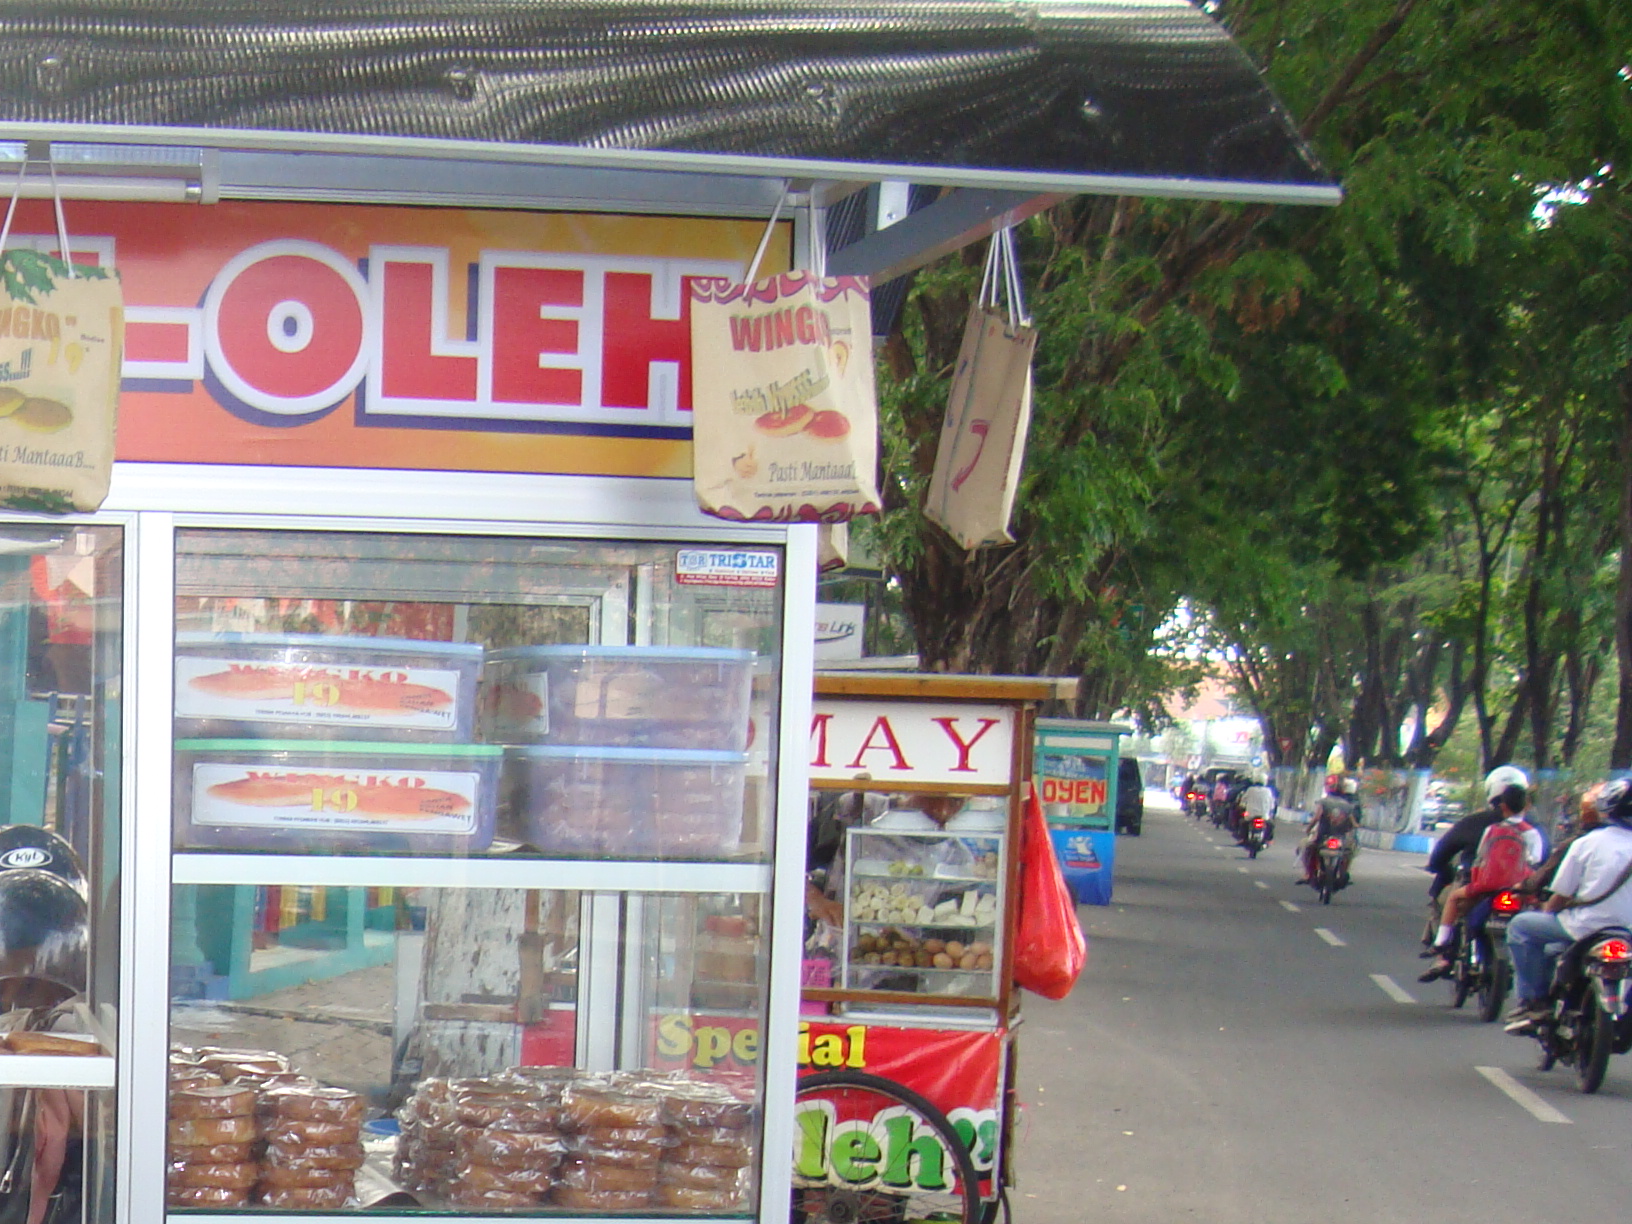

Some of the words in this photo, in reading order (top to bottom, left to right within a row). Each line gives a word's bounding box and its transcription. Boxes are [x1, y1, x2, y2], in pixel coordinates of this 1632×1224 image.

[768, 461, 798, 483] Pasti
[709, 553, 775, 569] TRISTAR
[293, 681, 340, 707] 19
[311, 787, 358, 813] 19
[1042, 779, 1106, 804] OYEN
[656, 1014, 867, 1069] Speial
